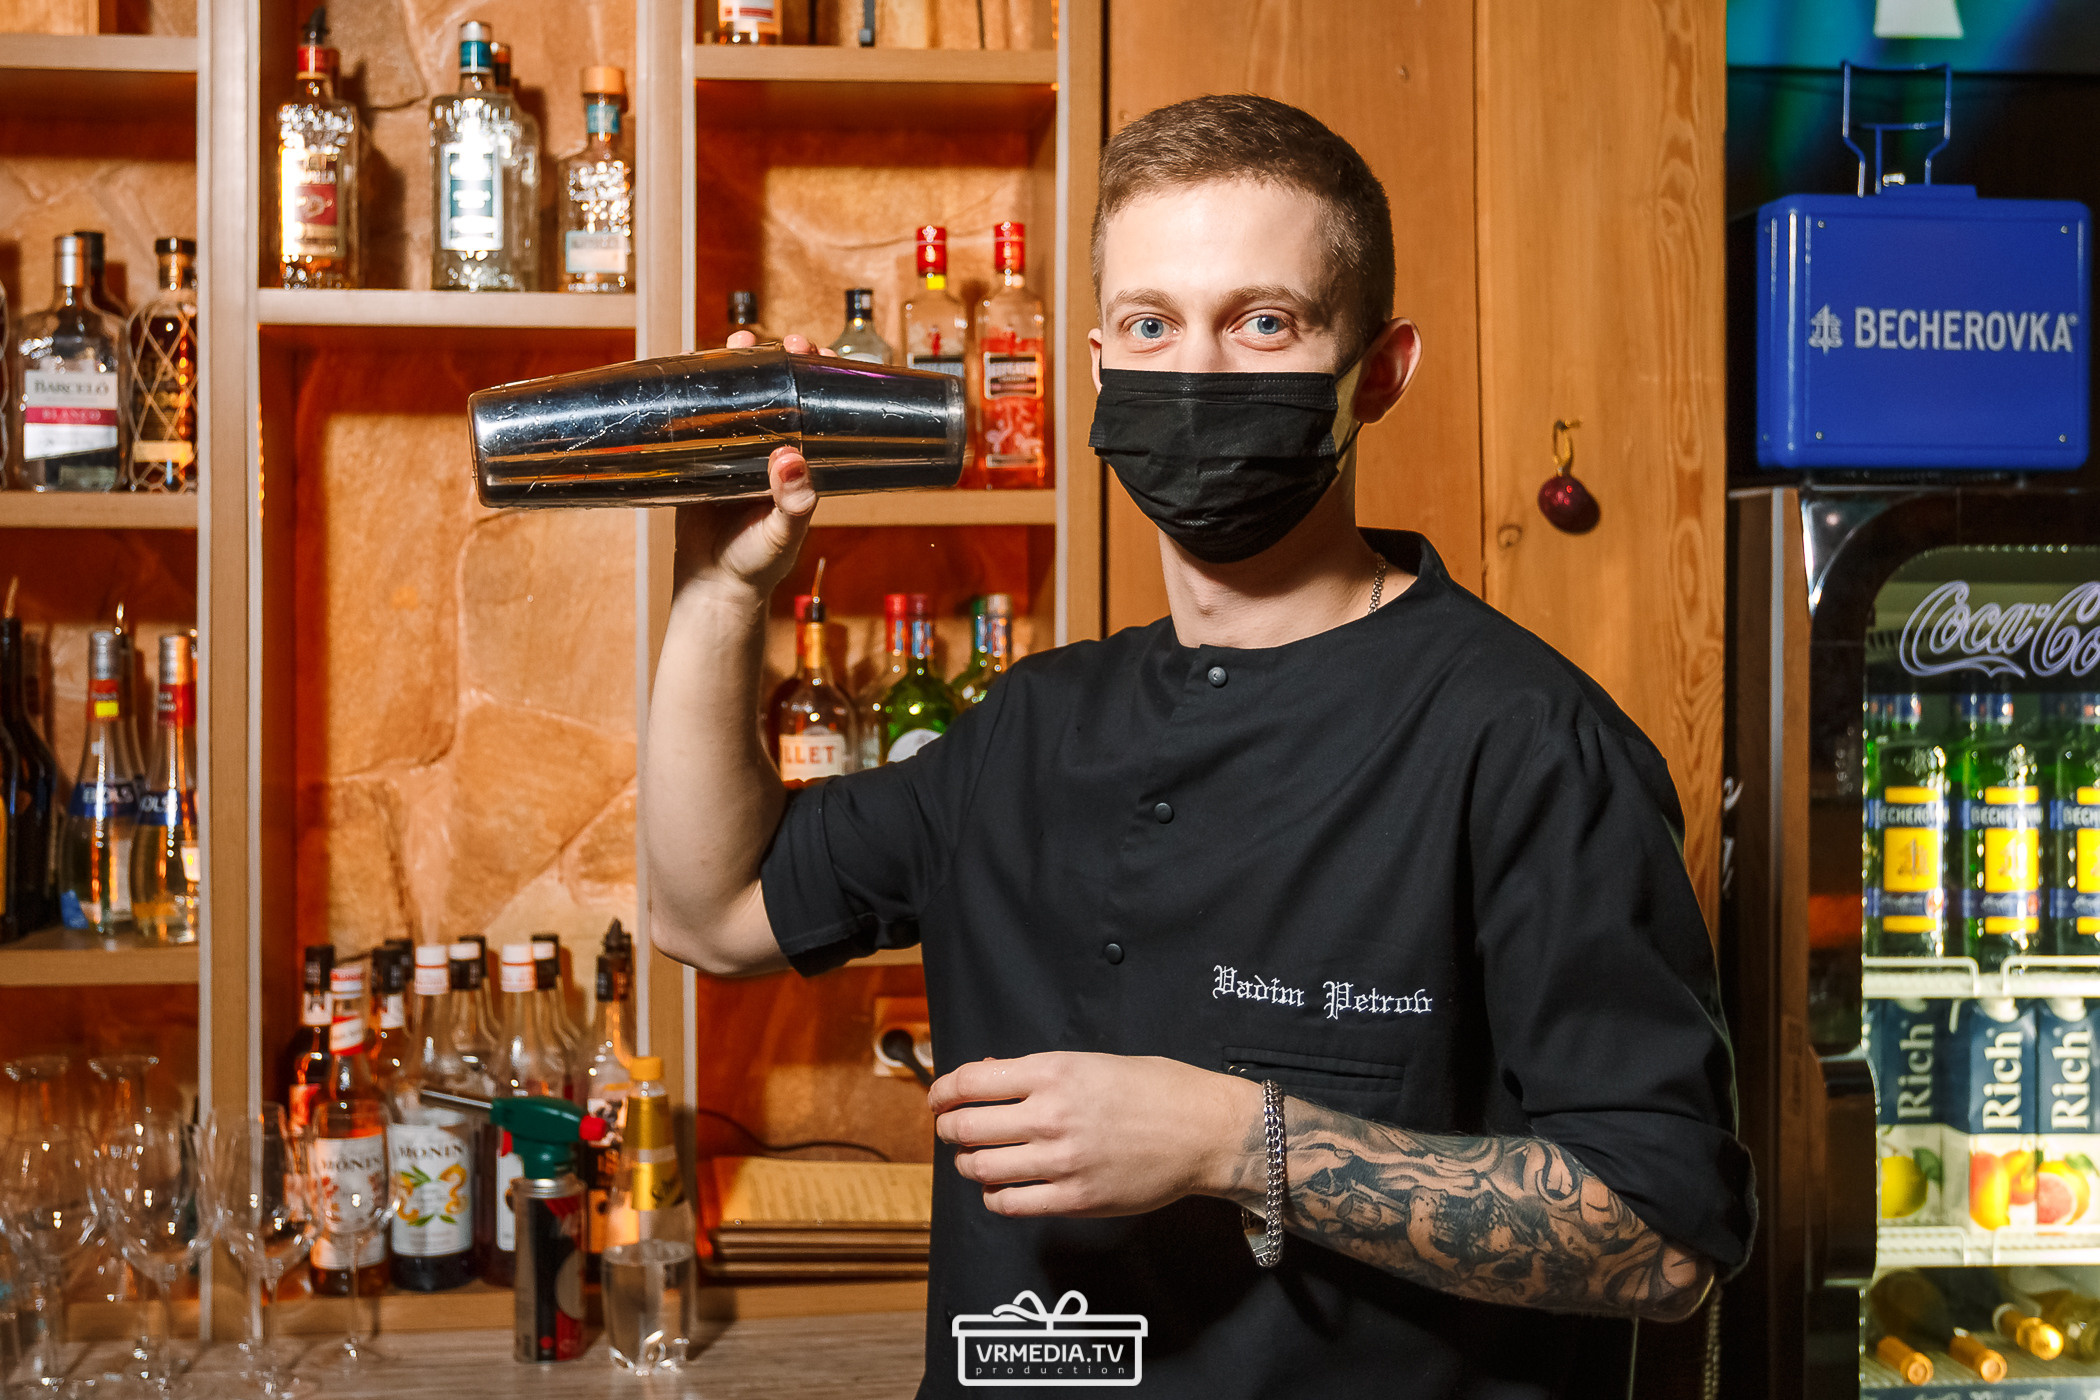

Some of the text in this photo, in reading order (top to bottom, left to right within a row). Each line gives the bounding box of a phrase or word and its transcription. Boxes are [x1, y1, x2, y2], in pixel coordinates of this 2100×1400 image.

[1854, 306, 2074, 352] BECHEROVKA
[1212, 964, 1305, 1007] Vadim
[1897, 1023, 1936, 1118] Rich
[1982, 1030, 2024, 1130] Rich
[2050, 1030, 2093, 1130] Rich
